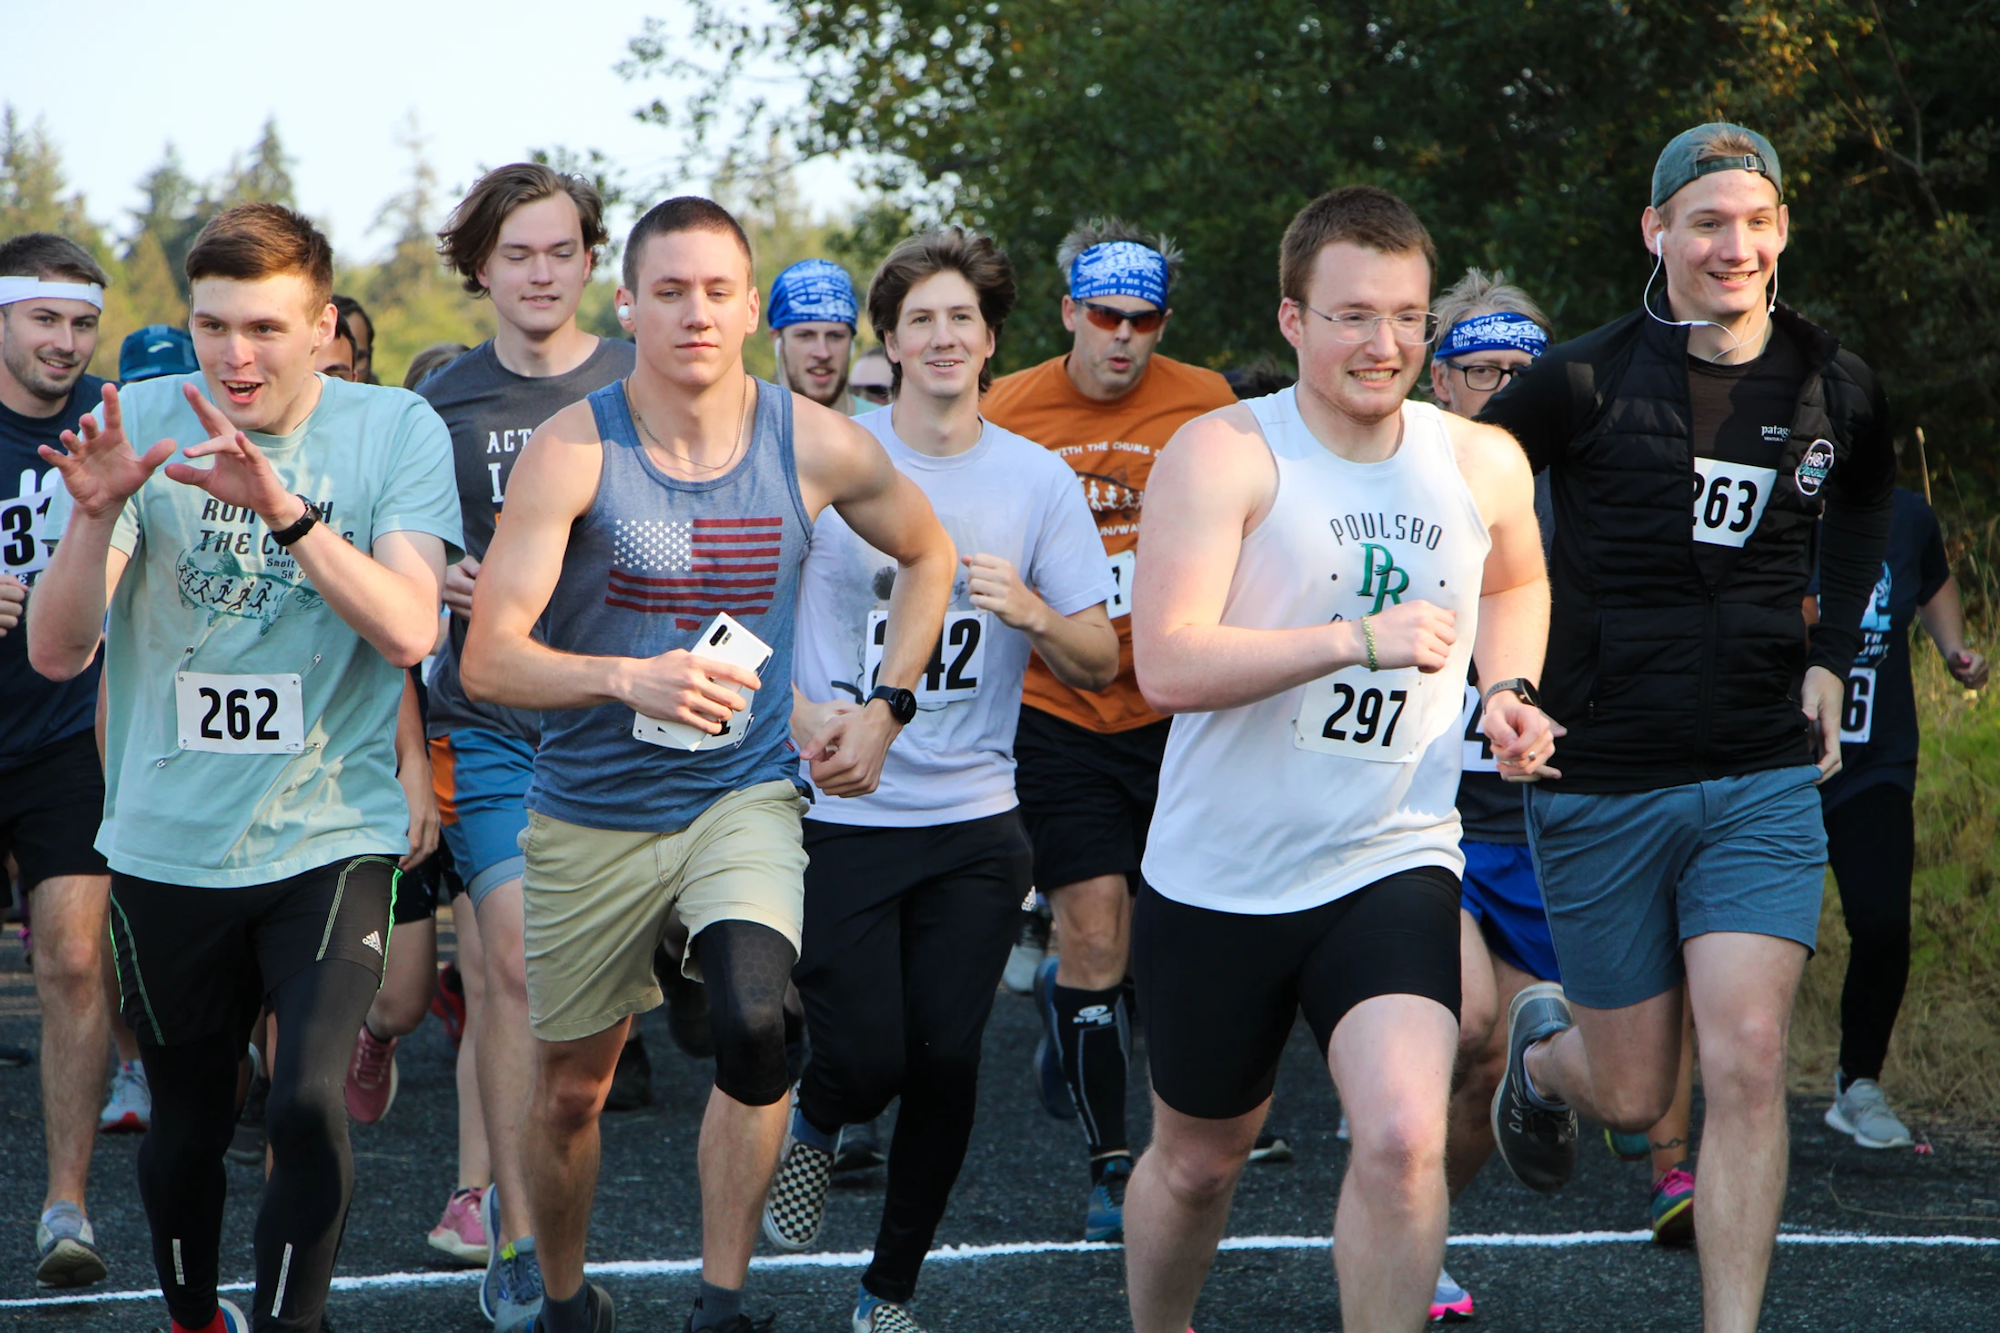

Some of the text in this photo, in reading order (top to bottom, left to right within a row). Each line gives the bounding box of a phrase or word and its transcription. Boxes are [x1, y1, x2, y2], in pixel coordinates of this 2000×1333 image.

[1087, 441, 1109, 452] THE
[1112, 441, 1150, 455] CHUMS
[200, 529, 252, 555] THE
[1330, 512, 1443, 551] POULSBO
[198, 687, 280, 740] 262
[1322, 683, 1408, 747] 297
[1841, 675, 1871, 733] 6
